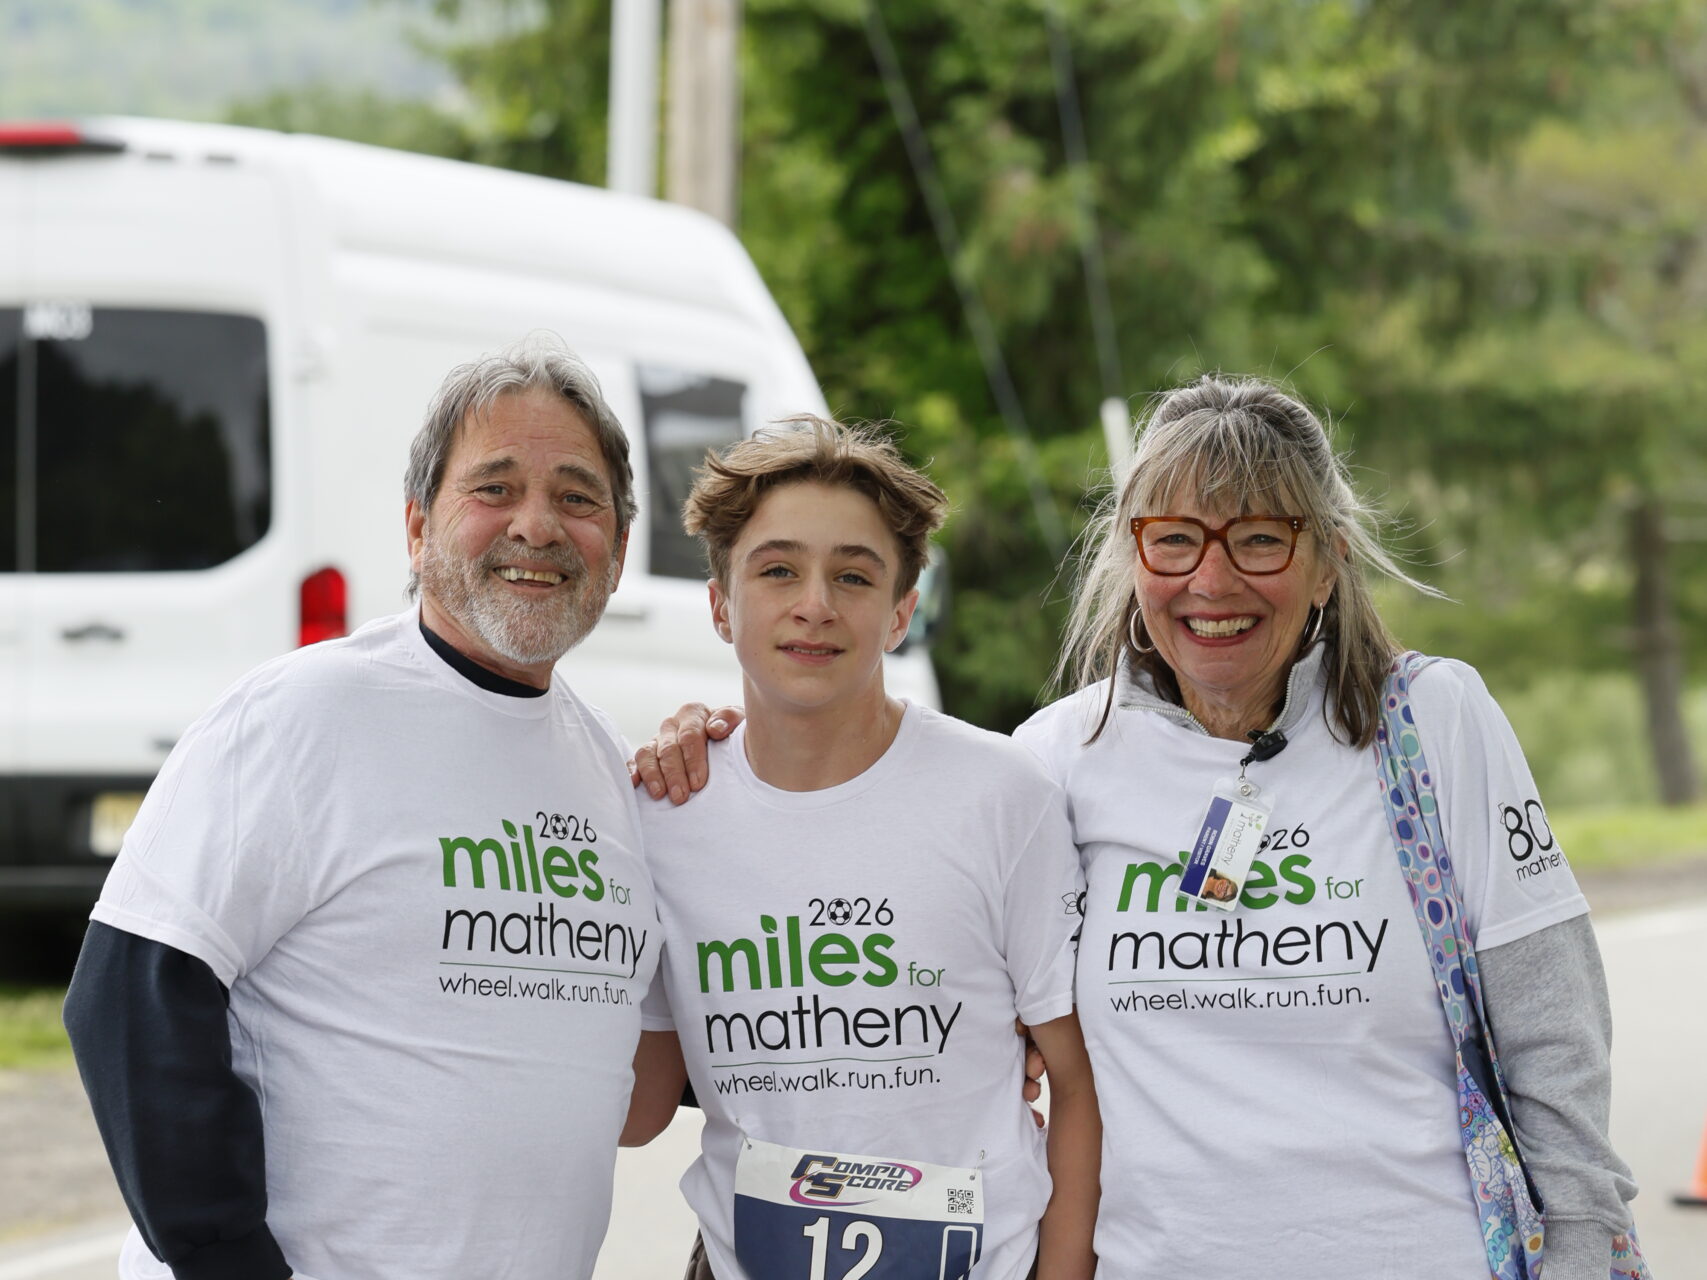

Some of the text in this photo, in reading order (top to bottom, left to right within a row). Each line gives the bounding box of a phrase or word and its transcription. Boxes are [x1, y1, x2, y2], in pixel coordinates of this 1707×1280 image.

[1221, 820, 1246, 866] matheny
[1504, 800, 1553, 861] 80
[439, 819, 631, 905] miles for
[1116, 851, 1364, 913] mes for
[442, 902, 646, 979] matheny
[696, 915, 945, 993] miles for
[1109, 919, 1388, 972] matheny
[439, 973, 632, 1006] wheel.walk.run.fun.
[1111, 984, 1370, 1013] wheel.walk.run.fun.
[705, 994, 962, 1054] matheny
[714, 1067, 941, 1094] wheel.walk.run.fun.
[791, 1154, 906, 1181] COMPU
[804, 1172, 914, 1199] SCORE
